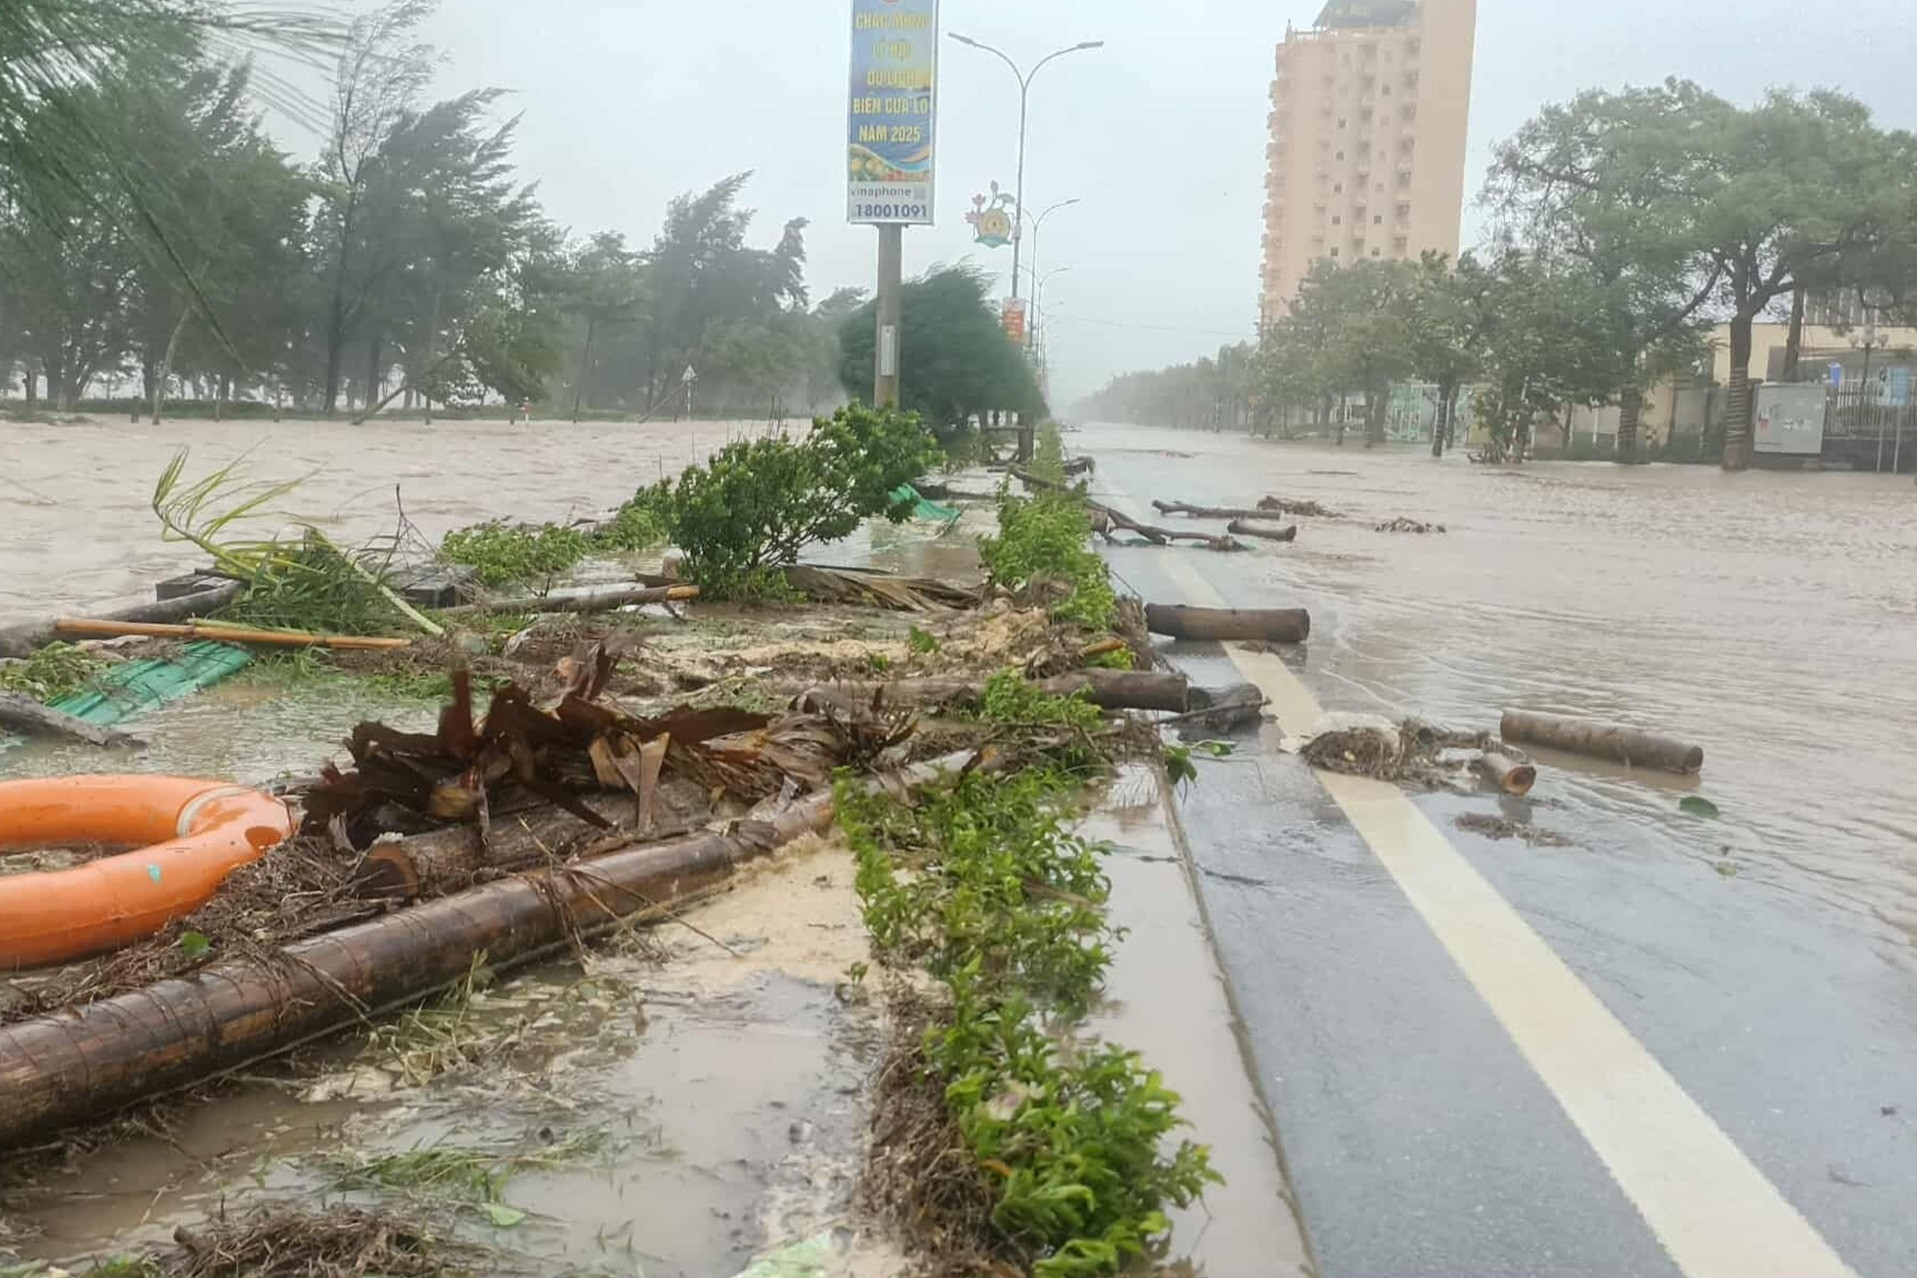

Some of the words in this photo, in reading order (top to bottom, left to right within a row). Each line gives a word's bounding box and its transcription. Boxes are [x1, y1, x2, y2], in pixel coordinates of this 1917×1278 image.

[890, 125, 922, 143] 2025
[851, 186, 912, 198] vinaphone
[856, 204, 927, 217] 18001091
